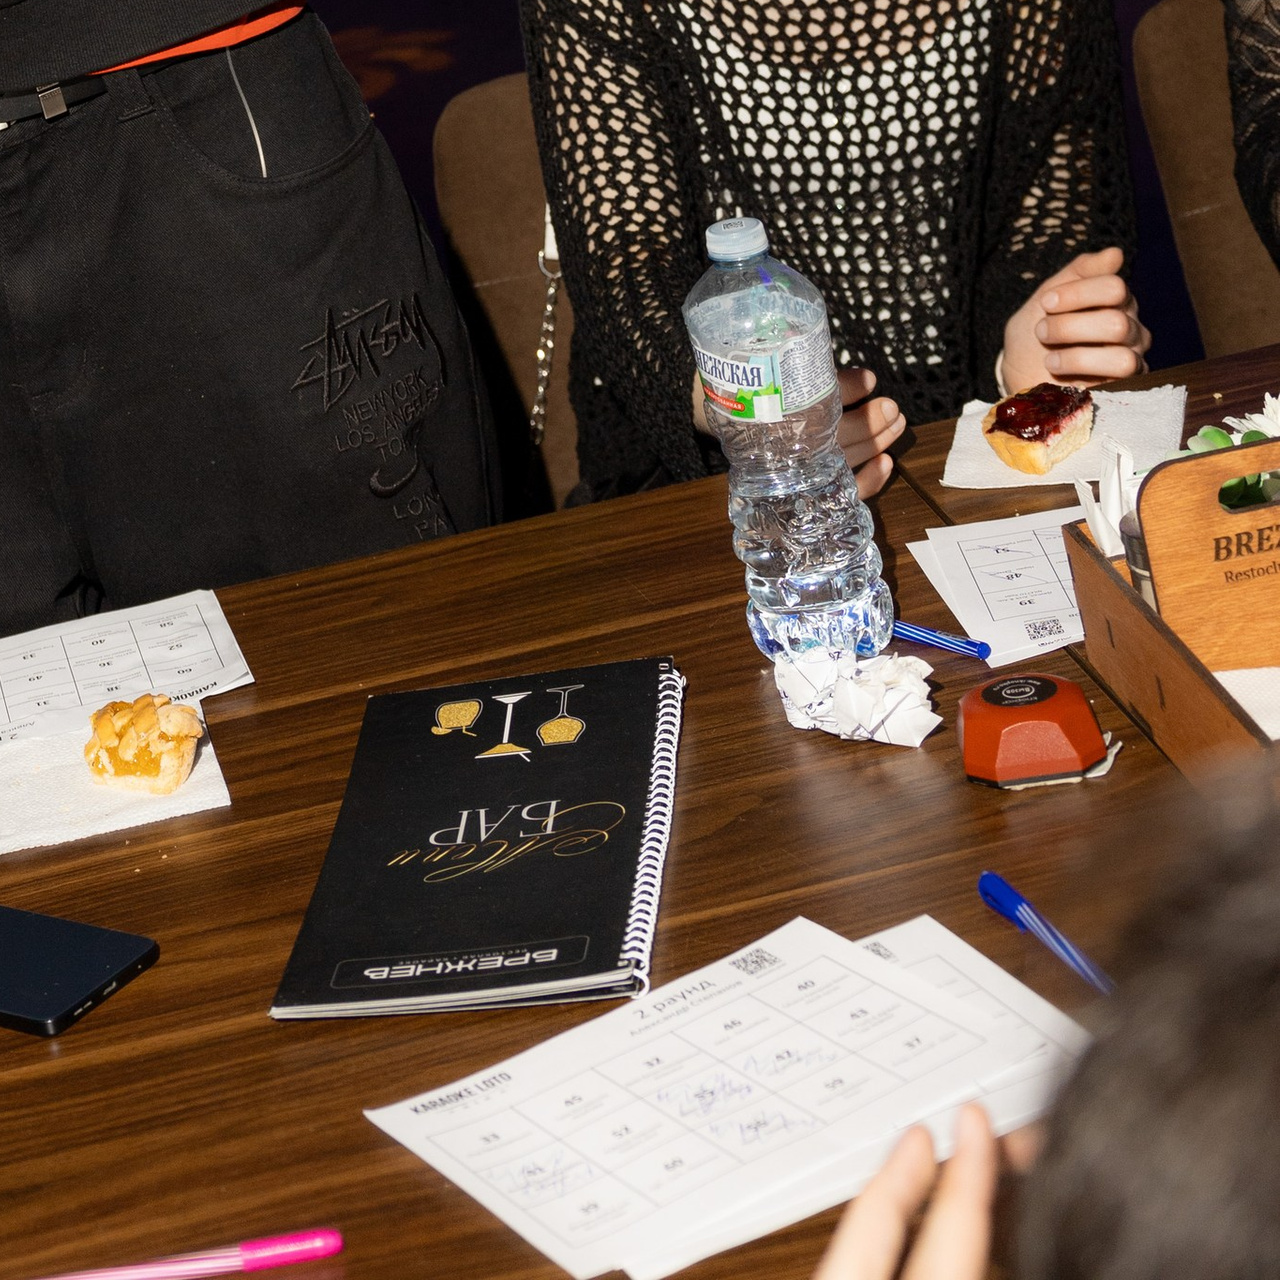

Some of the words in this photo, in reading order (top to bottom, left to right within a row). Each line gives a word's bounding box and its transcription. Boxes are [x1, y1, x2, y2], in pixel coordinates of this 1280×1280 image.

[694, 348, 763, 388] НЕЖСКАЯ
[335, 424, 376, 453] LOS
[1019, 598, 1036, 606] 39
[168, 643, 183, 651] 52
[169, 681, 218, 702] KARAOK
[428, 799, 561, 846] БАР
[363, 948, 558, 980] БРЕЖНЕВ
[797, 980, 815, 991] 40
[633, 1009, 649, 1020] 2
[652, 978, 718, 1016] раунд
[724, 1019, 742, 1030] 46
[409, 1088, 477, 1117] KARAOKE
[477, 1071, 512, 1093] LOTO
[482, 1133, 500, 1144] 33
